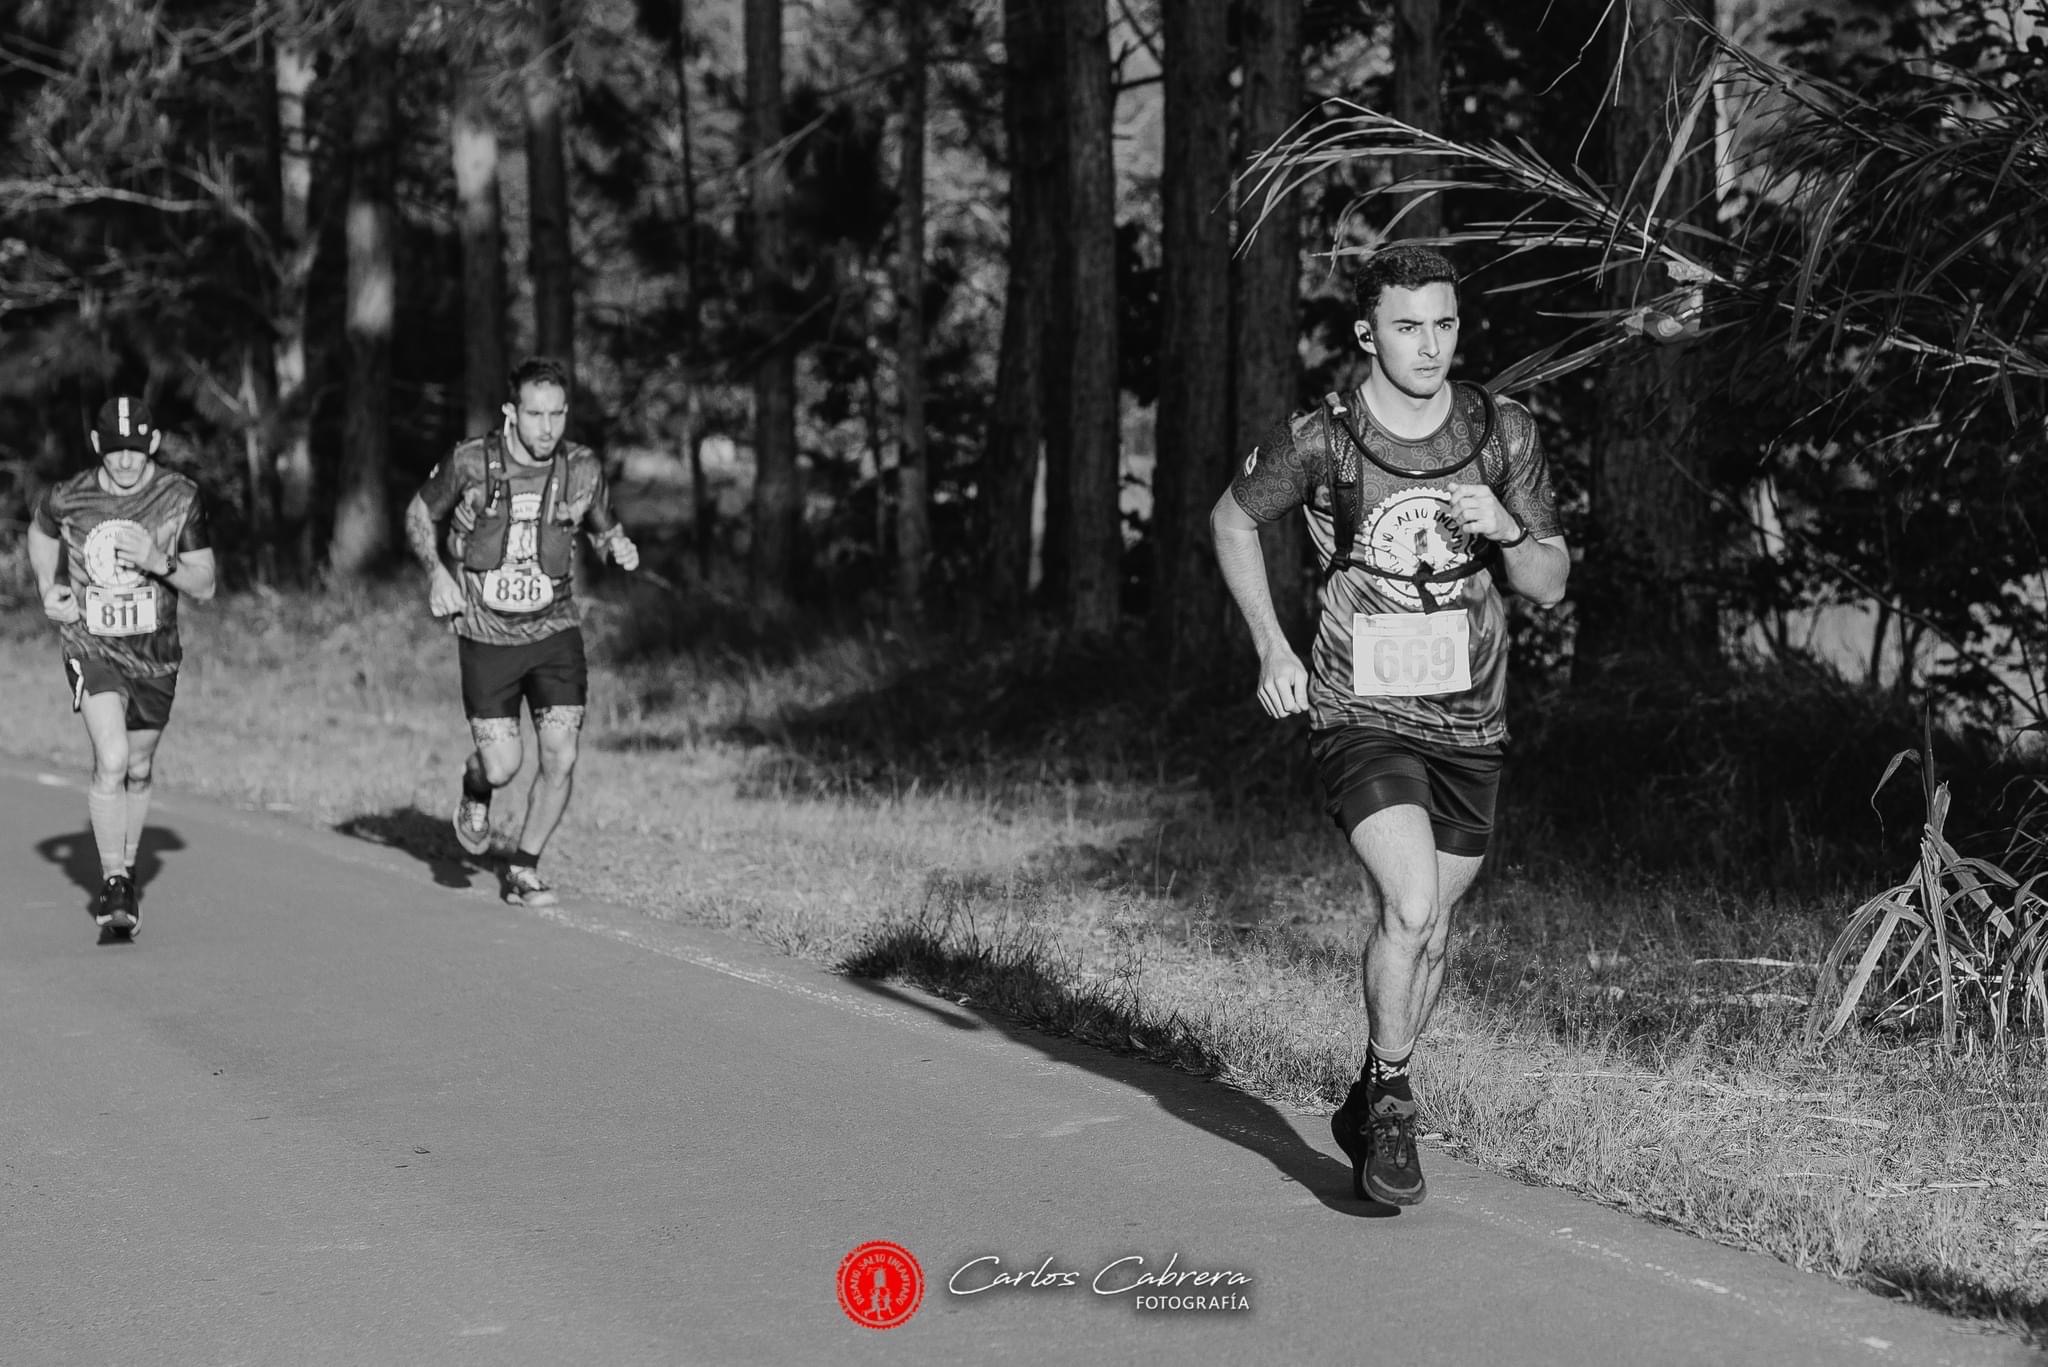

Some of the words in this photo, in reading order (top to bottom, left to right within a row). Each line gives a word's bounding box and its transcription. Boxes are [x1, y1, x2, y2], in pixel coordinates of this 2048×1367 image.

[496, 577, 541, 601] 836
[102, 604, 138, 627] 811
[1373, 636, 1456, 683] 669
